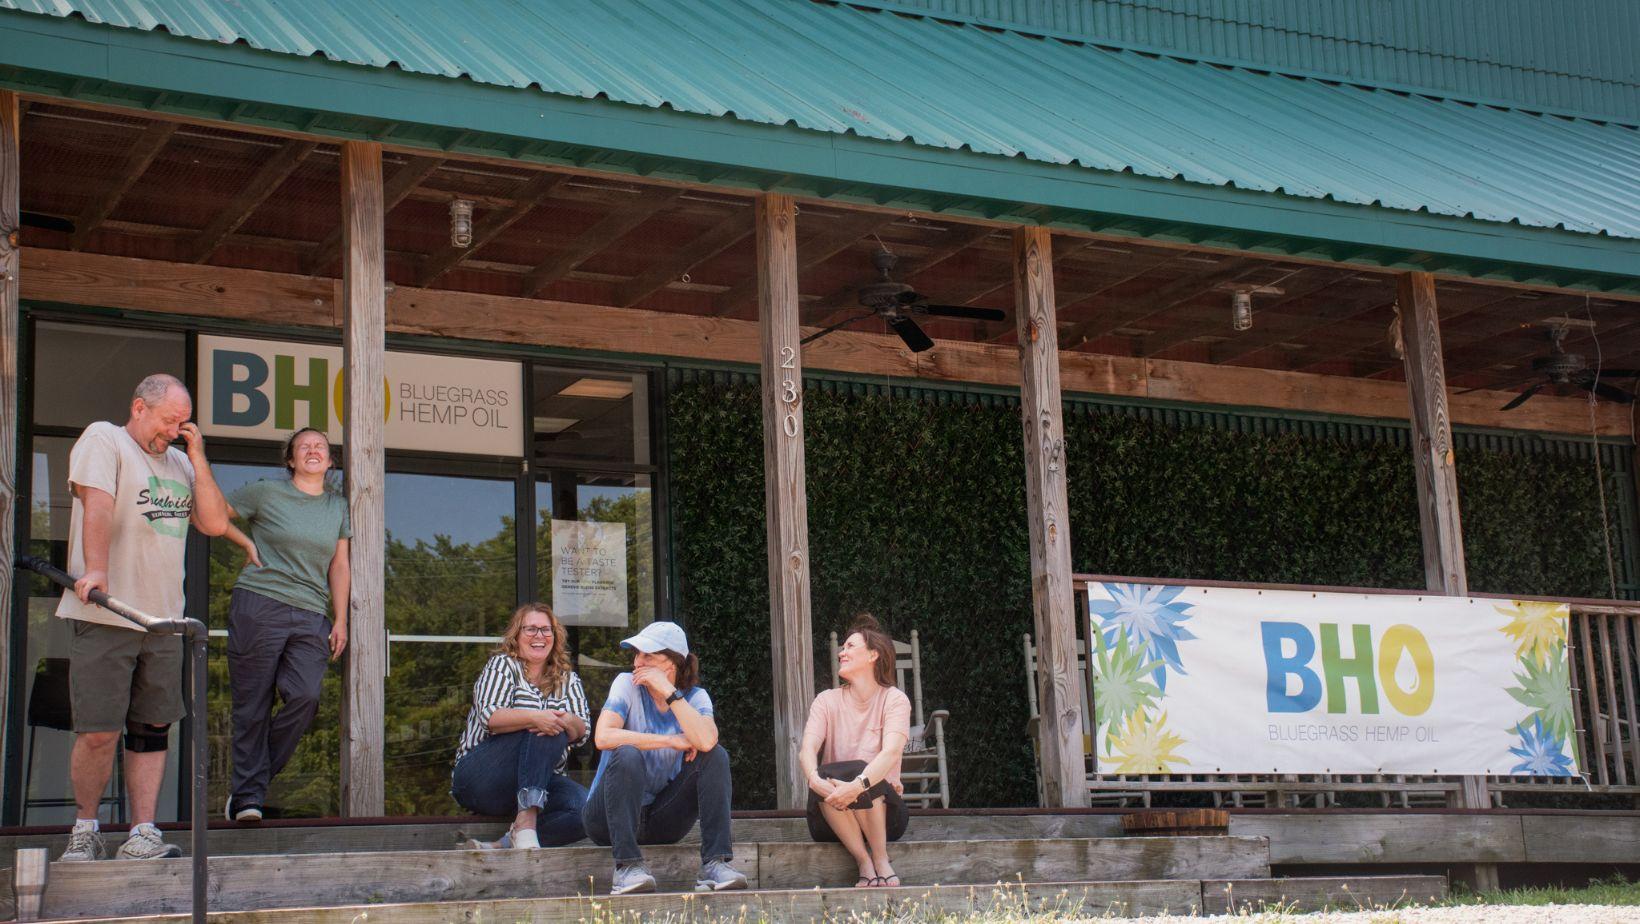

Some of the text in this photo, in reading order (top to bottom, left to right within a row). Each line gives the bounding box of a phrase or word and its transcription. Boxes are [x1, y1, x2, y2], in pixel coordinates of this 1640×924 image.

[212, 349, 391, 432] BH
[399, 382, 509, 407] BLUEGRASS
[399, 401, 509, 429] HEMP OIL
[780, 346, 798, 437] 230
[1260, 621, 1435, 717] BHO
[1268, 724, 1439, 743] BLUEGRASS HEMP OIL
